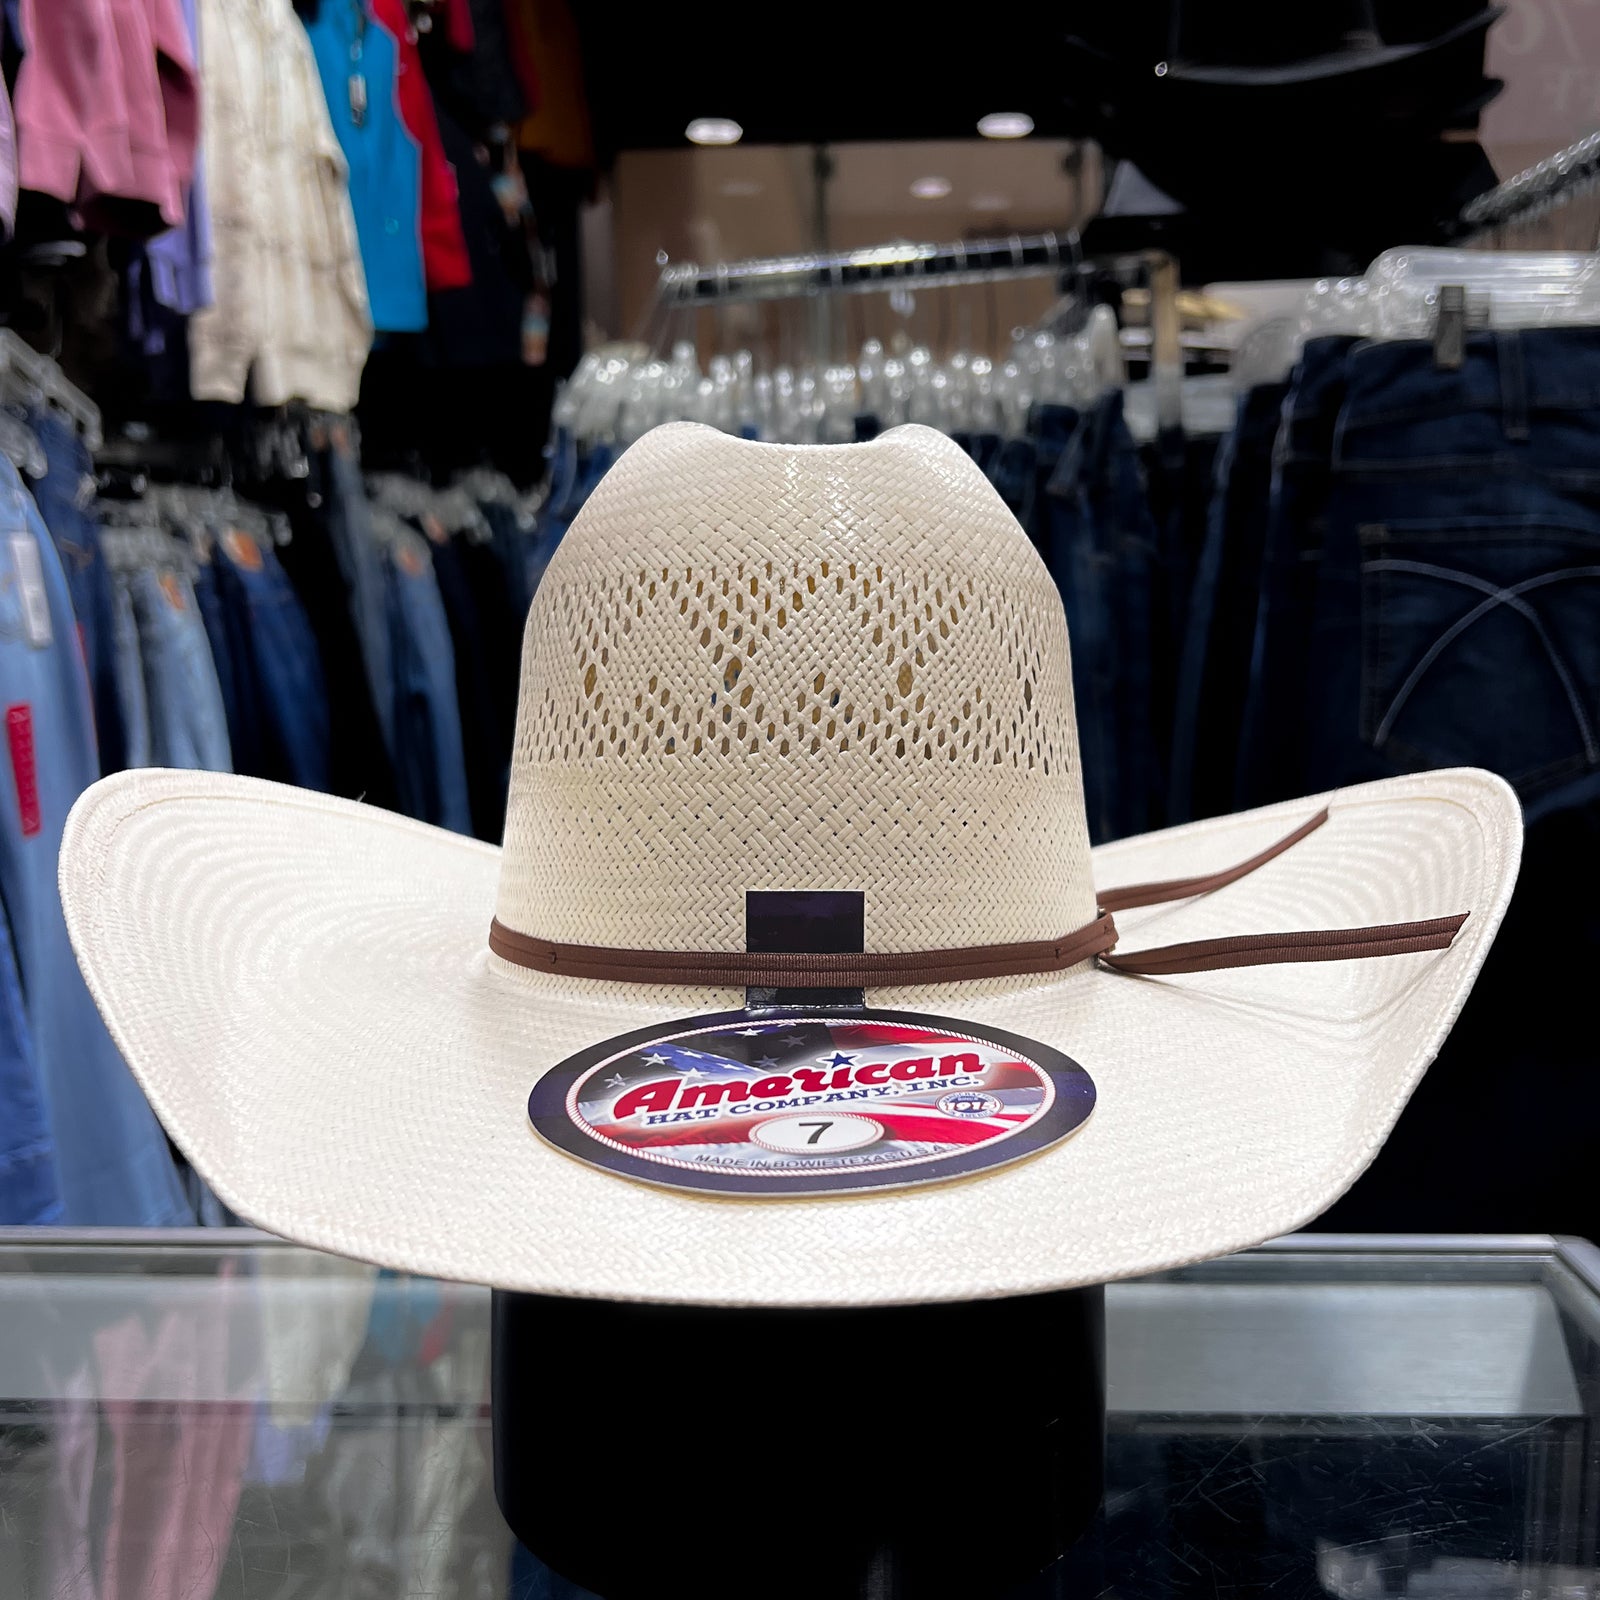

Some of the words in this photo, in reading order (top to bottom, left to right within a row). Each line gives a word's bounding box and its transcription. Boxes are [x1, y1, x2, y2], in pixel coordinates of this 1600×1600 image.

[613, 1052, 986, 1119] American
[647, 1107, 718, 1125] HAT
[729, 1086, 899, 1115] COMPANY,
[906, 1076, 979, 1092] INC.
[798, 1122, 834, 1145] 7
[694, 1154, 745, 1166] MADE
[750, 1159, 768, 1168] IN
[840, 1151, 897, 1165] TEXAS
